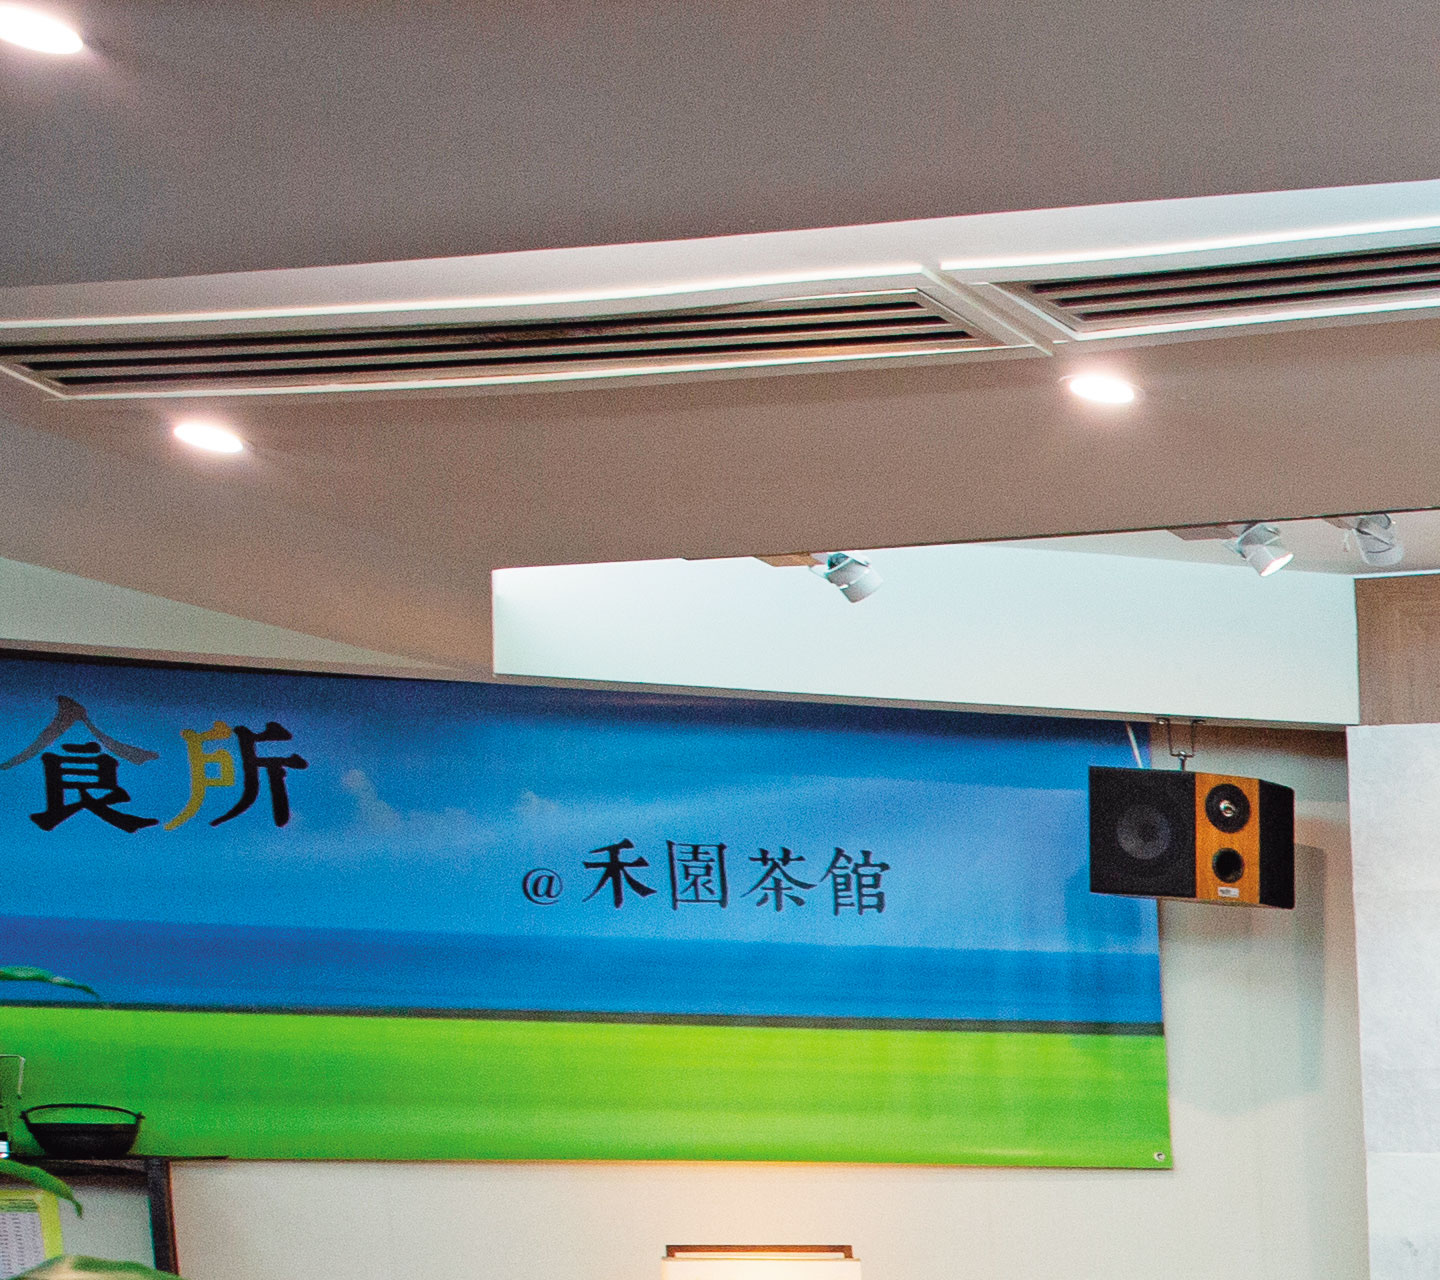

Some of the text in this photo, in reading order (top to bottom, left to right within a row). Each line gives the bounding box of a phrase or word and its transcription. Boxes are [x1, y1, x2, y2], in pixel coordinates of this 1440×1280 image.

[0, 695, 308, 833] 食所
[522, 839, 892, 916] @ 禾園茶館
